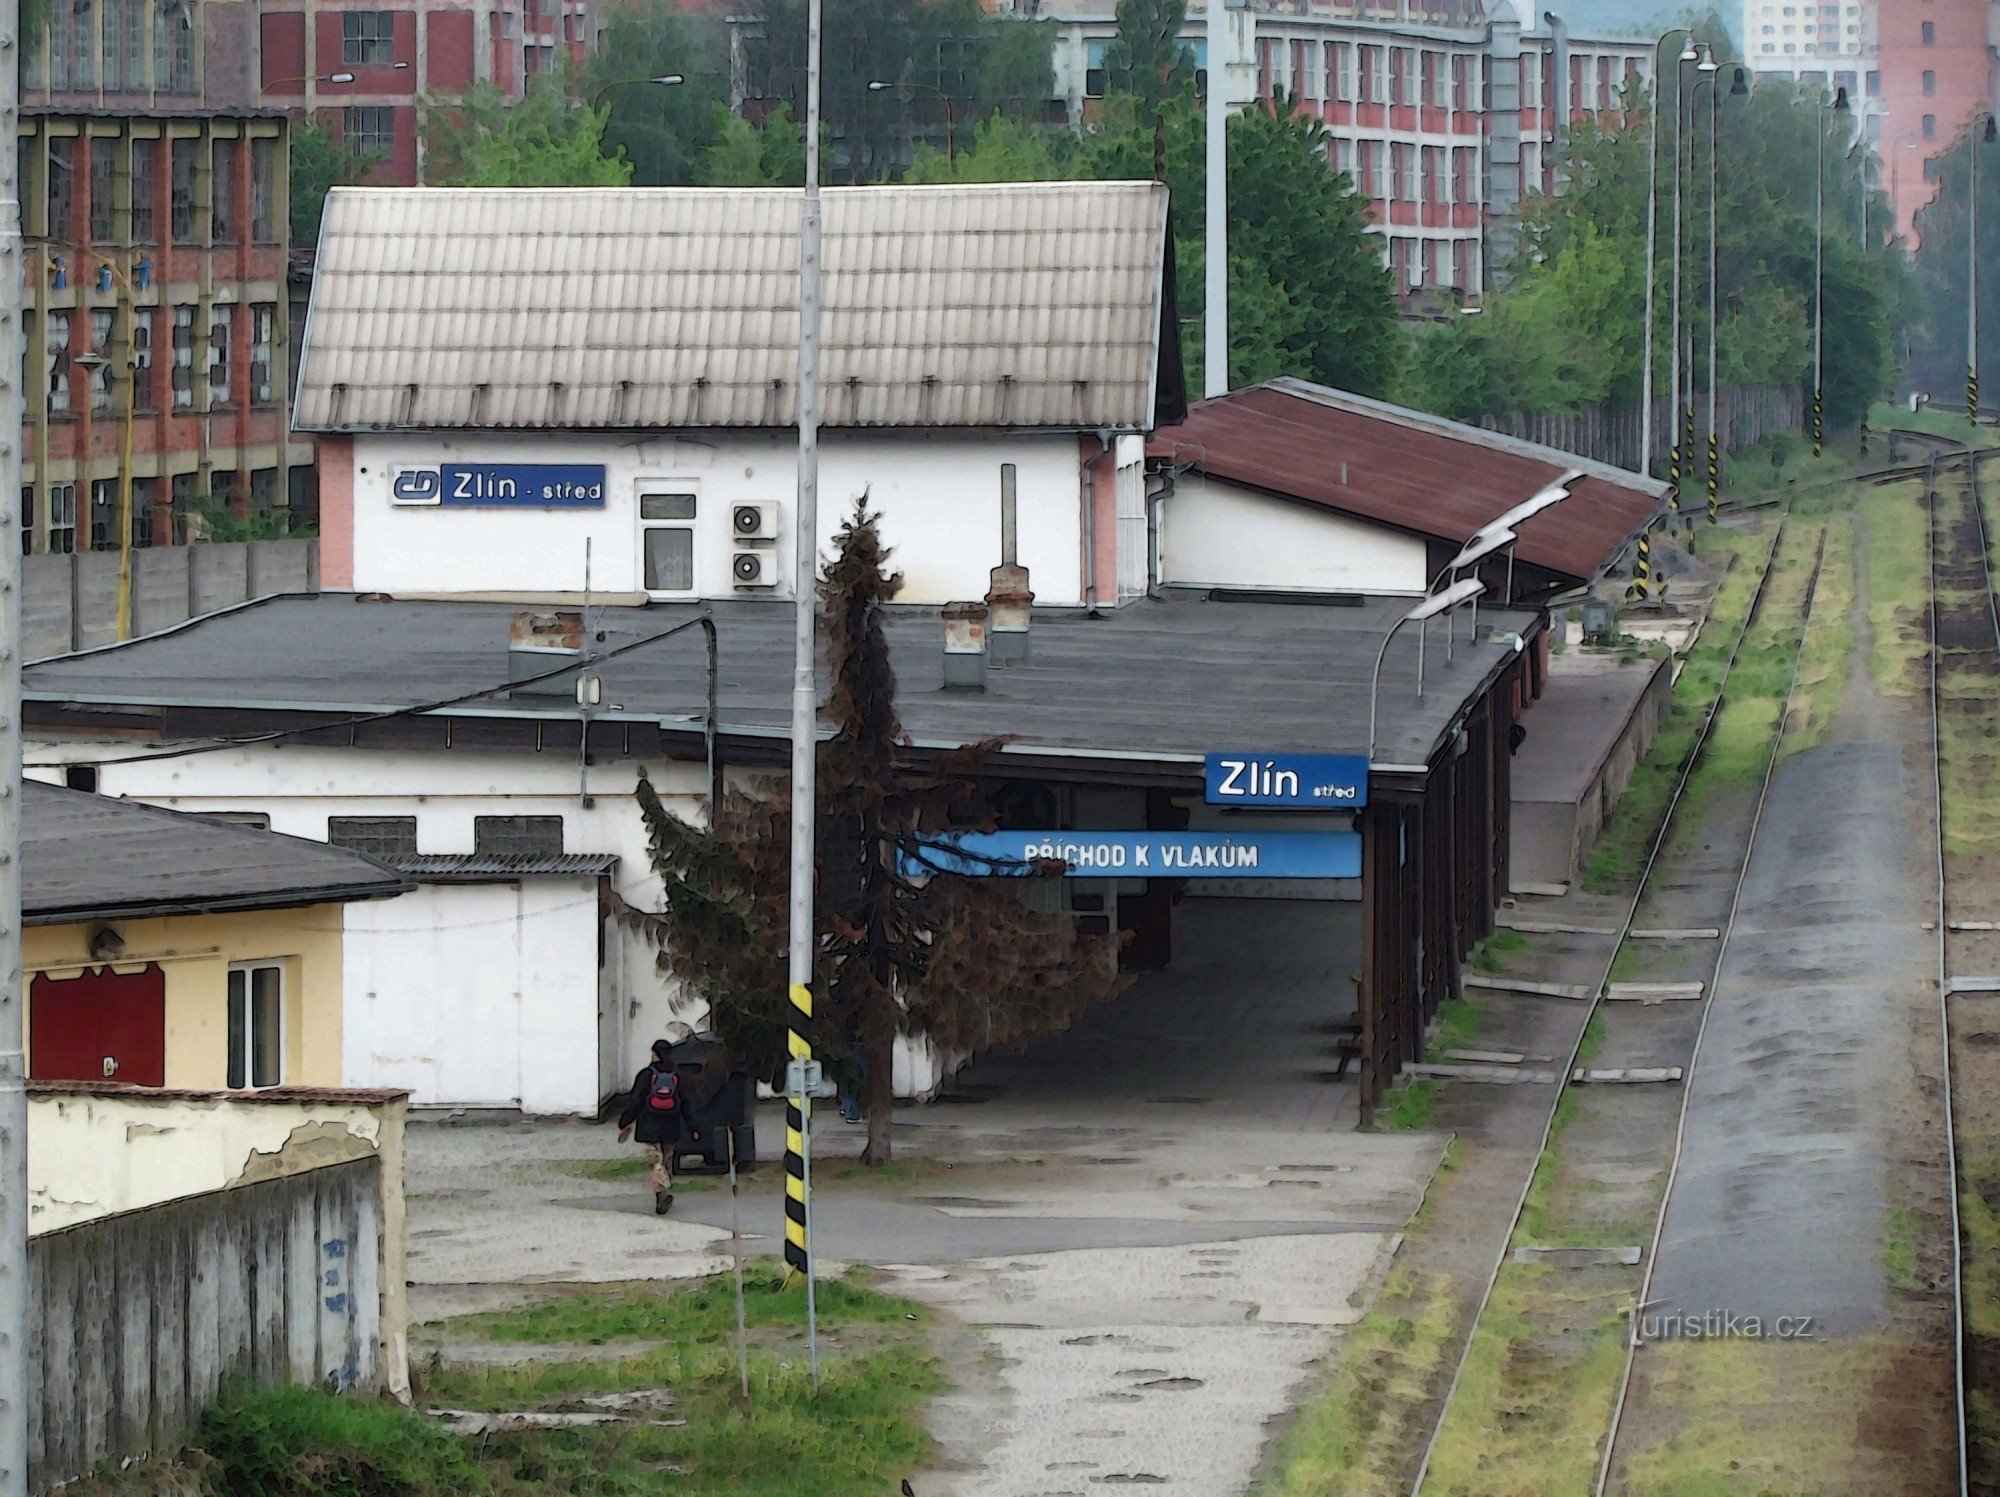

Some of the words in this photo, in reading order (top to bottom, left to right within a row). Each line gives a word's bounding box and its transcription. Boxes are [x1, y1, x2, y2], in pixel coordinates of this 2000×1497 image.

[453, 471, 516, 499] Zlín
[542, 481, 601, 499] střed
[1218, 760, 1299, 797] Zlín
[1313, 783, 1356, 799] střed
[1024, 838, 1126, 868] PŘÍCHOD
[1135, 844, 1150, 867] K
[1160, 838, 1258, 868] VLAKŮM
